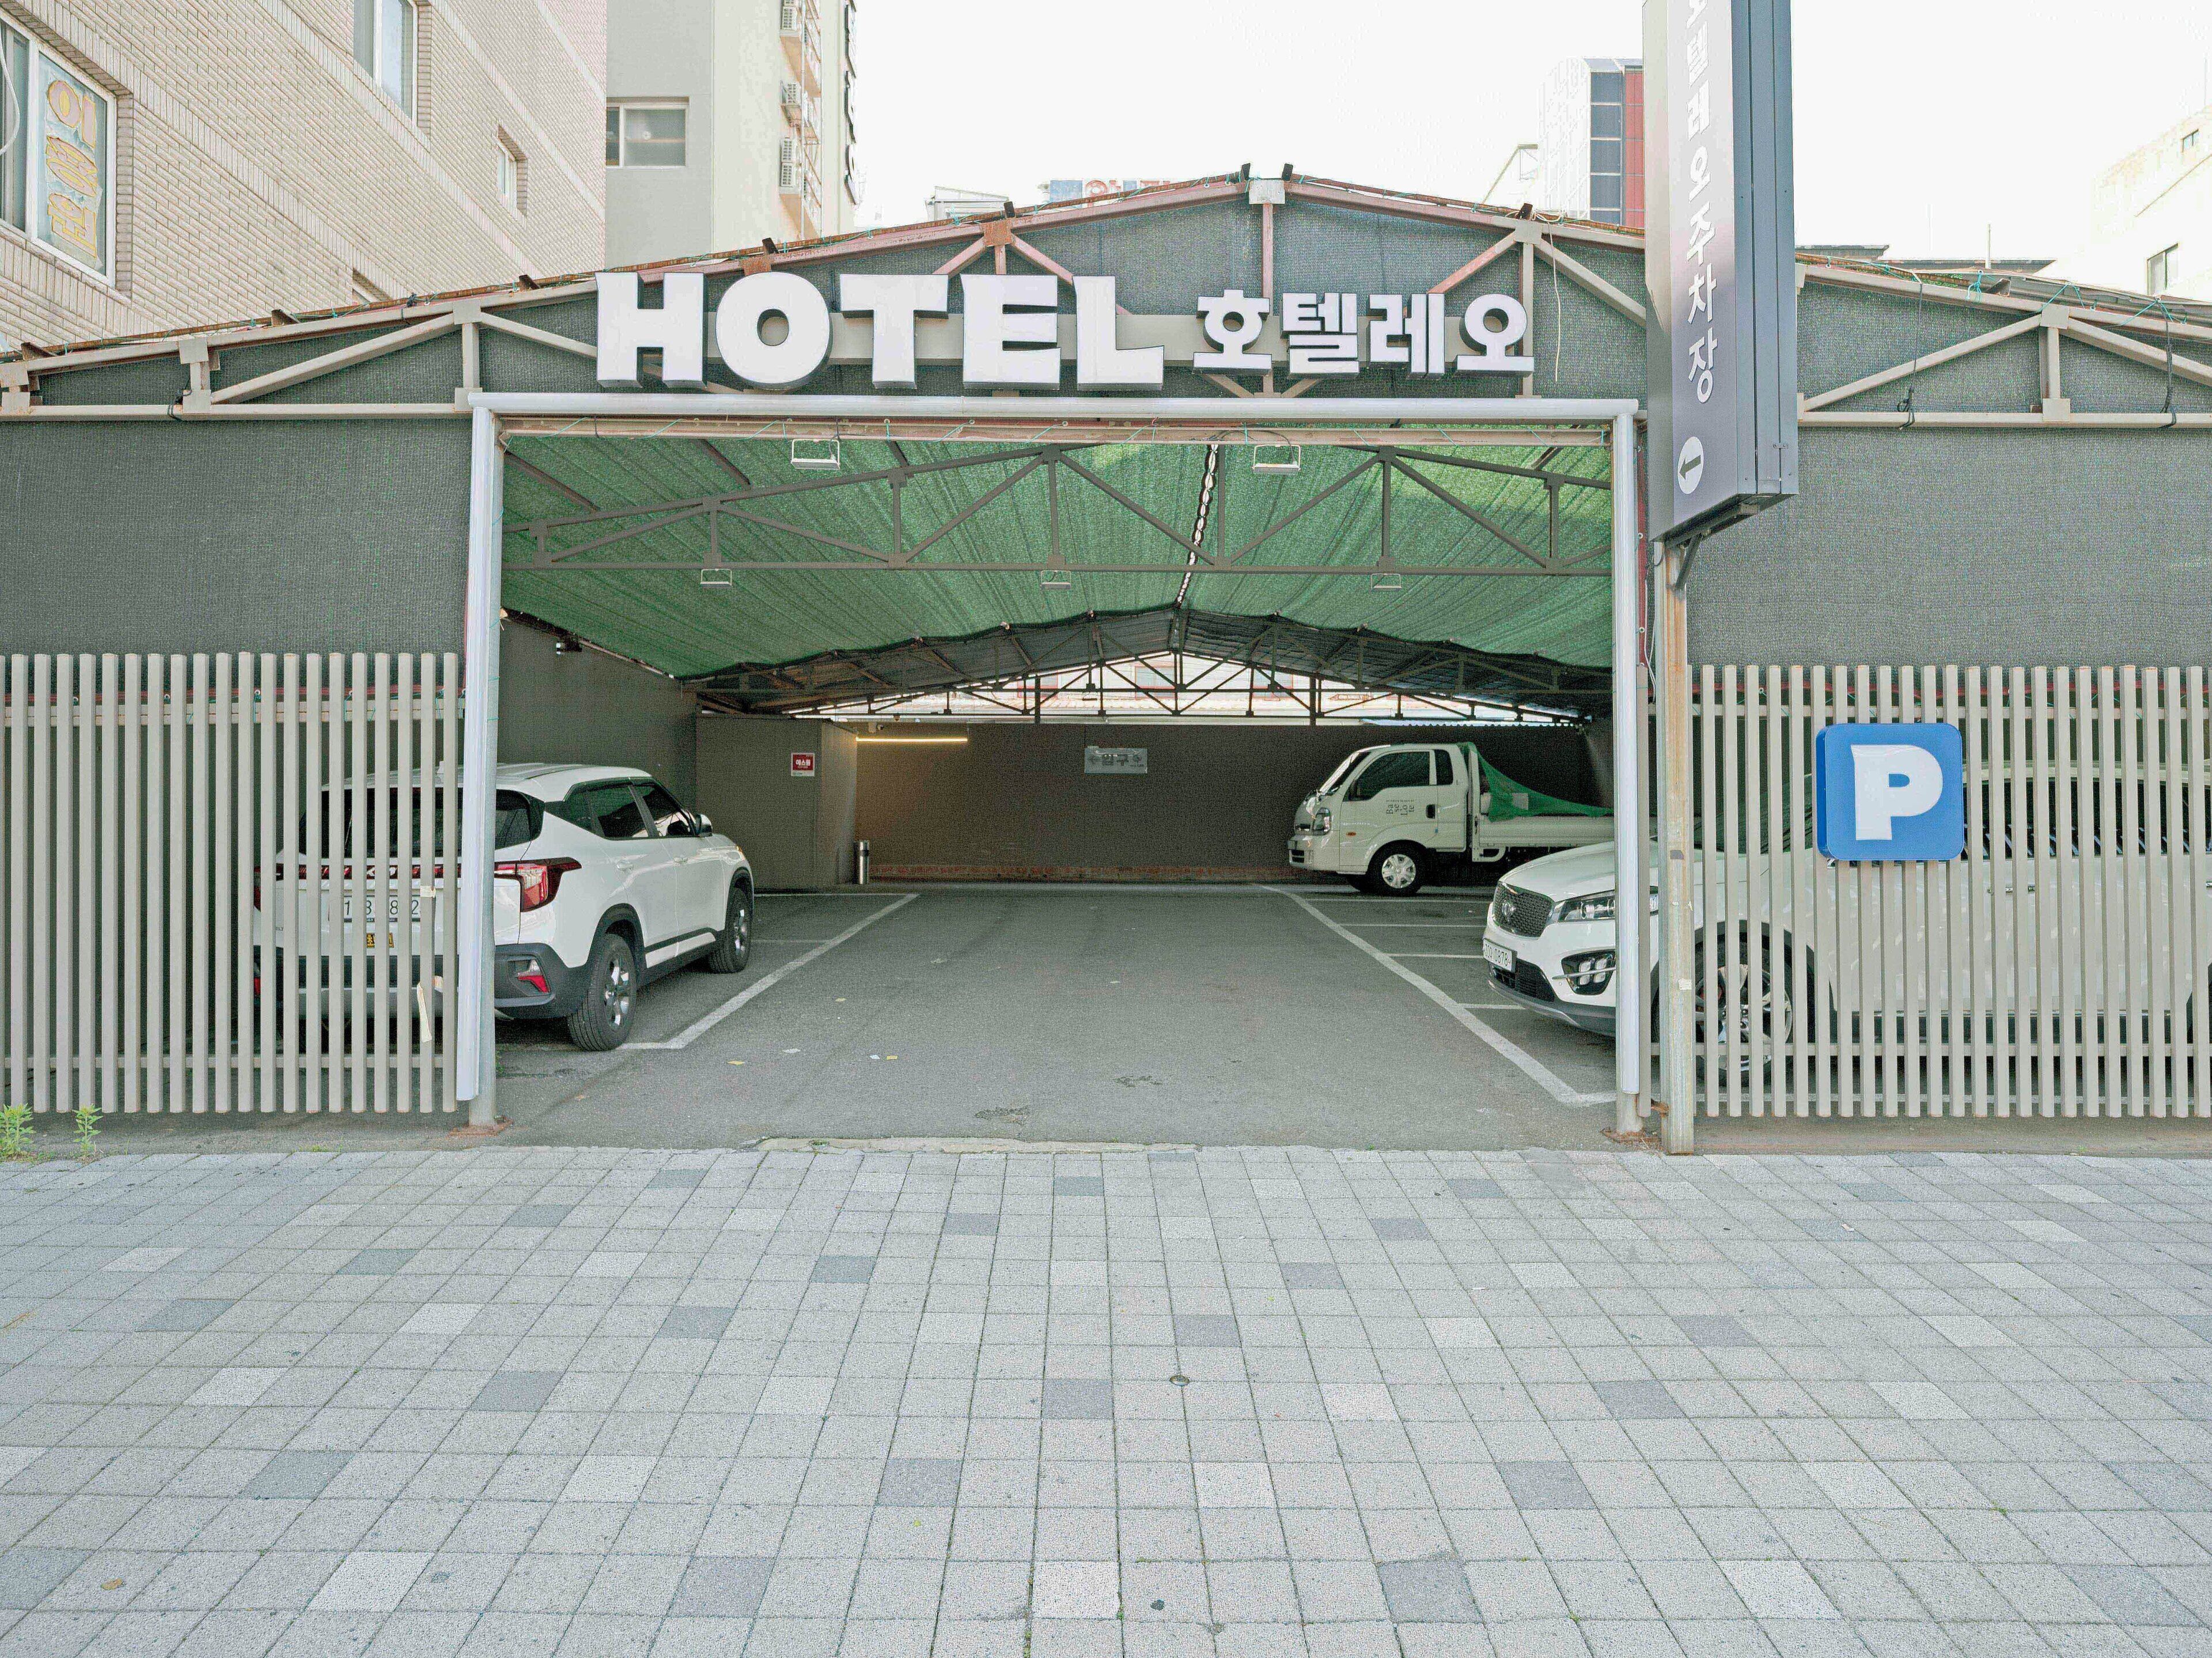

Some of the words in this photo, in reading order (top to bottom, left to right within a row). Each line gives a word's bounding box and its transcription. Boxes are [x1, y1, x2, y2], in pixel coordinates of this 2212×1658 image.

[595, 271, 1165, 388] HOTEL
[1193, 289, 1535, 378] 호텔레오
[1851, 744, 1944, 840] P
